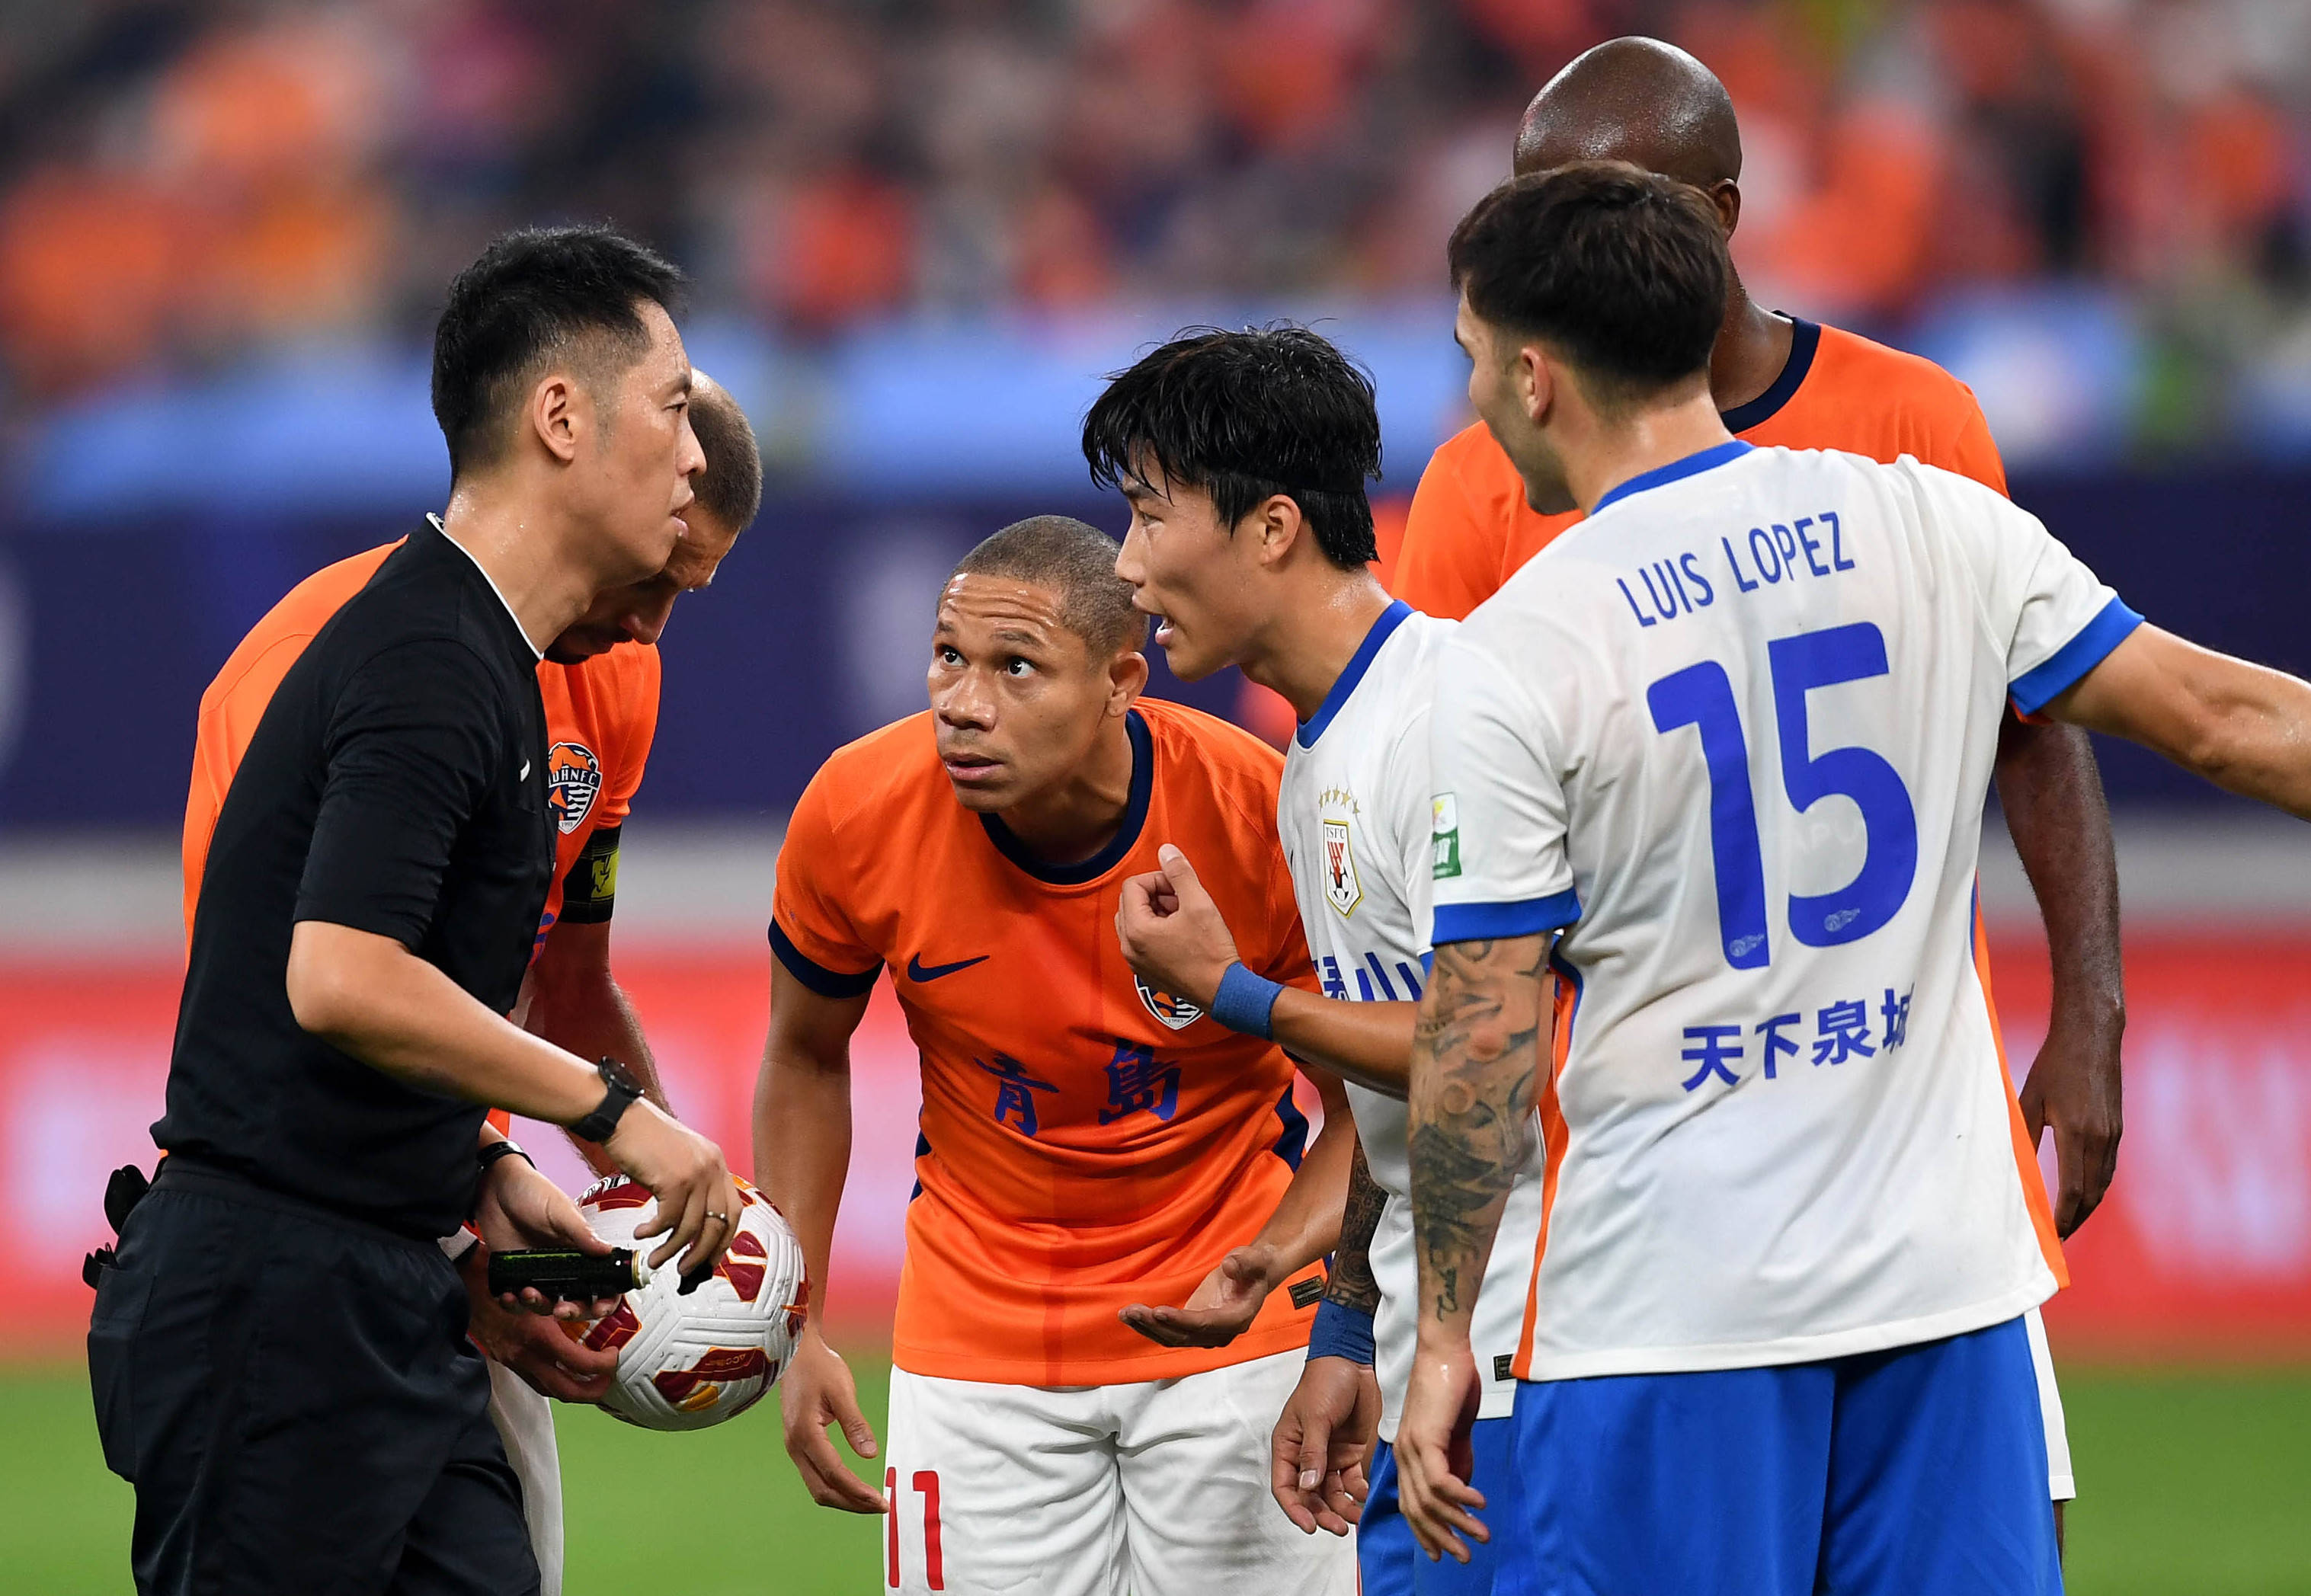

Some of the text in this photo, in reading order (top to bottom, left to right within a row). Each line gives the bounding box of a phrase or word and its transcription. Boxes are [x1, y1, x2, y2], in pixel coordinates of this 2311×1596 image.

[1616, 511, 1855, 628] LUIS LOPEZ
[549, 769, 597, 785] DHNFC
[1326, 827, 1345, 840] TSFC
[1647, 621, 1918, 971] 15
[885, 1466, 944, 1591] 11
